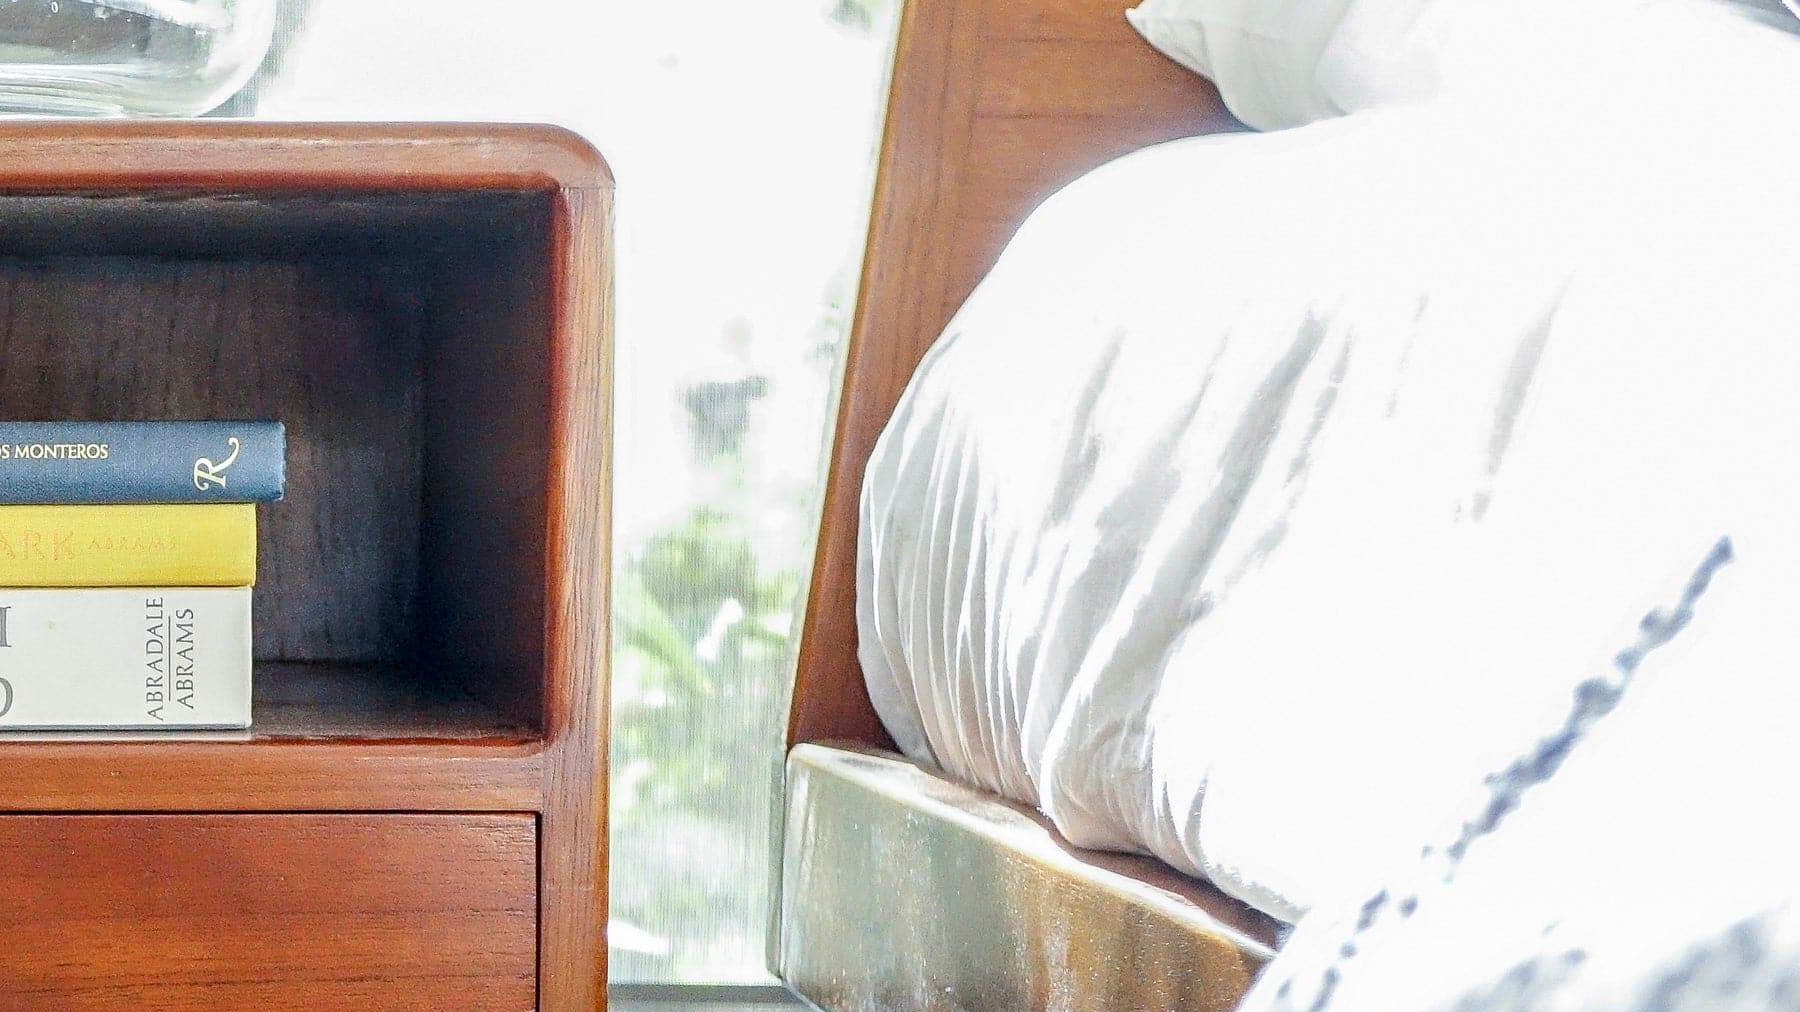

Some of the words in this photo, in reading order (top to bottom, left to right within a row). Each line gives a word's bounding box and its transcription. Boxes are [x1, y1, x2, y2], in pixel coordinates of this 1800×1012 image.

[14, 444, 109, 459] MONTEROS
[86, 537, 178, 552] ABRAMS
[145, 596, 165, 722] ABRADALE
[176, 607, 195, 710] ABRAMS
